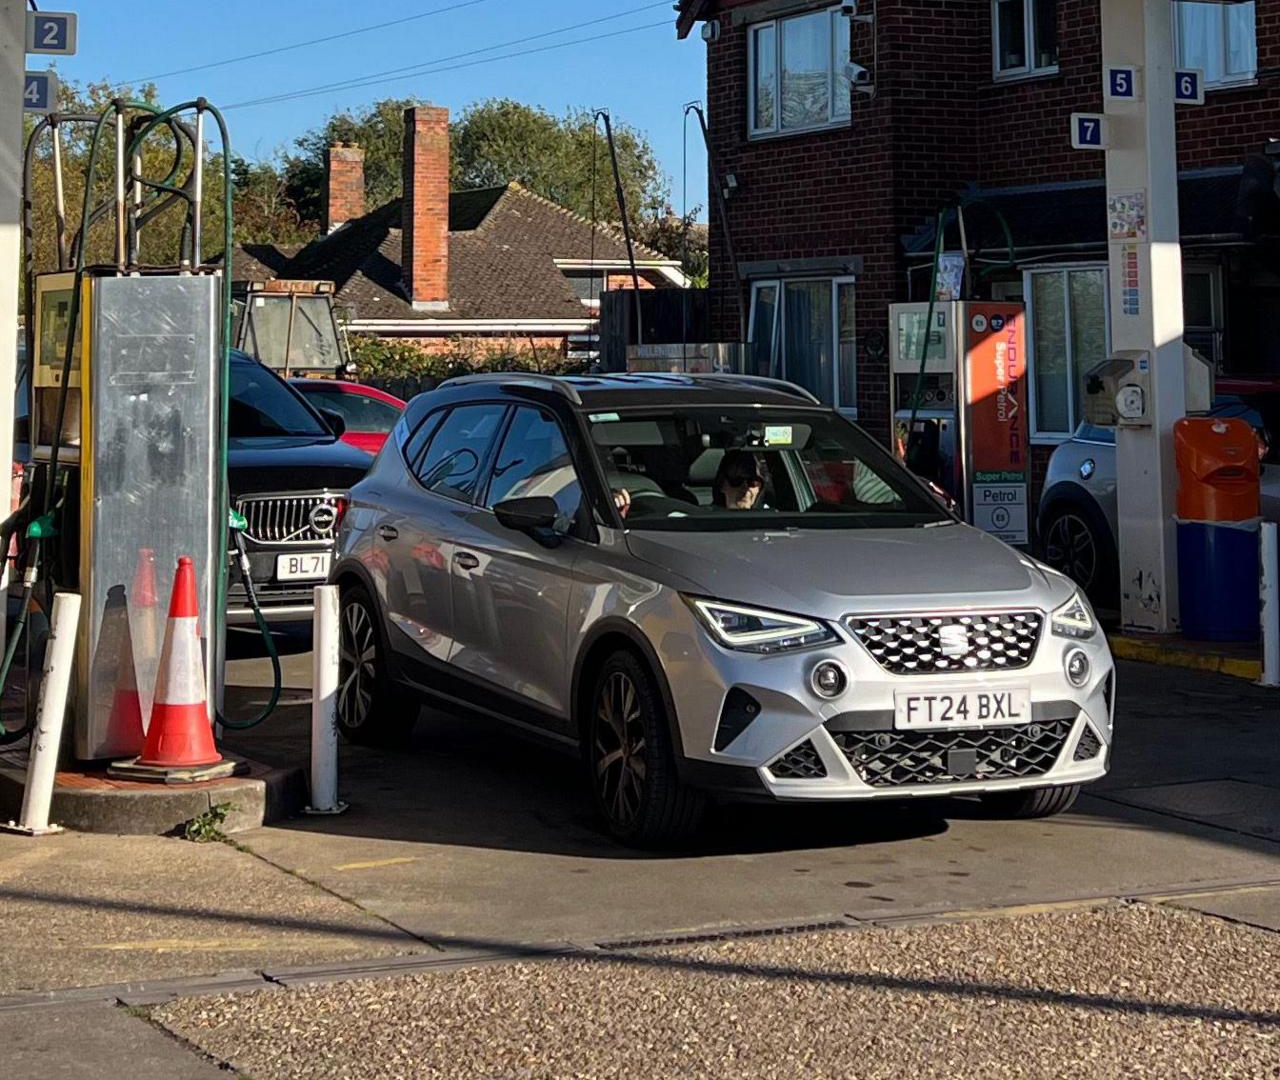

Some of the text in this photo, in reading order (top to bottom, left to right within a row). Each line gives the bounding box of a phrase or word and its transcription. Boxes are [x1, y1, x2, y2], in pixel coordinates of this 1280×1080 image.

[42, 22, 59, 45] 2
[24, 81, 39, 103] 4
[1116, 73, 1127, 93] 5
[1181, 76, 1192, 96] 6
[1083, 123, 1095, 141] 7
[995, 342, 1006, 383] Super
[976, 472, 1024, 482] Super Petrol
[984, 490, 1017, 502] Petrol
[288, 556, 325, 575] BL71
[907, 693, 1020, 722] FT24 BXL
